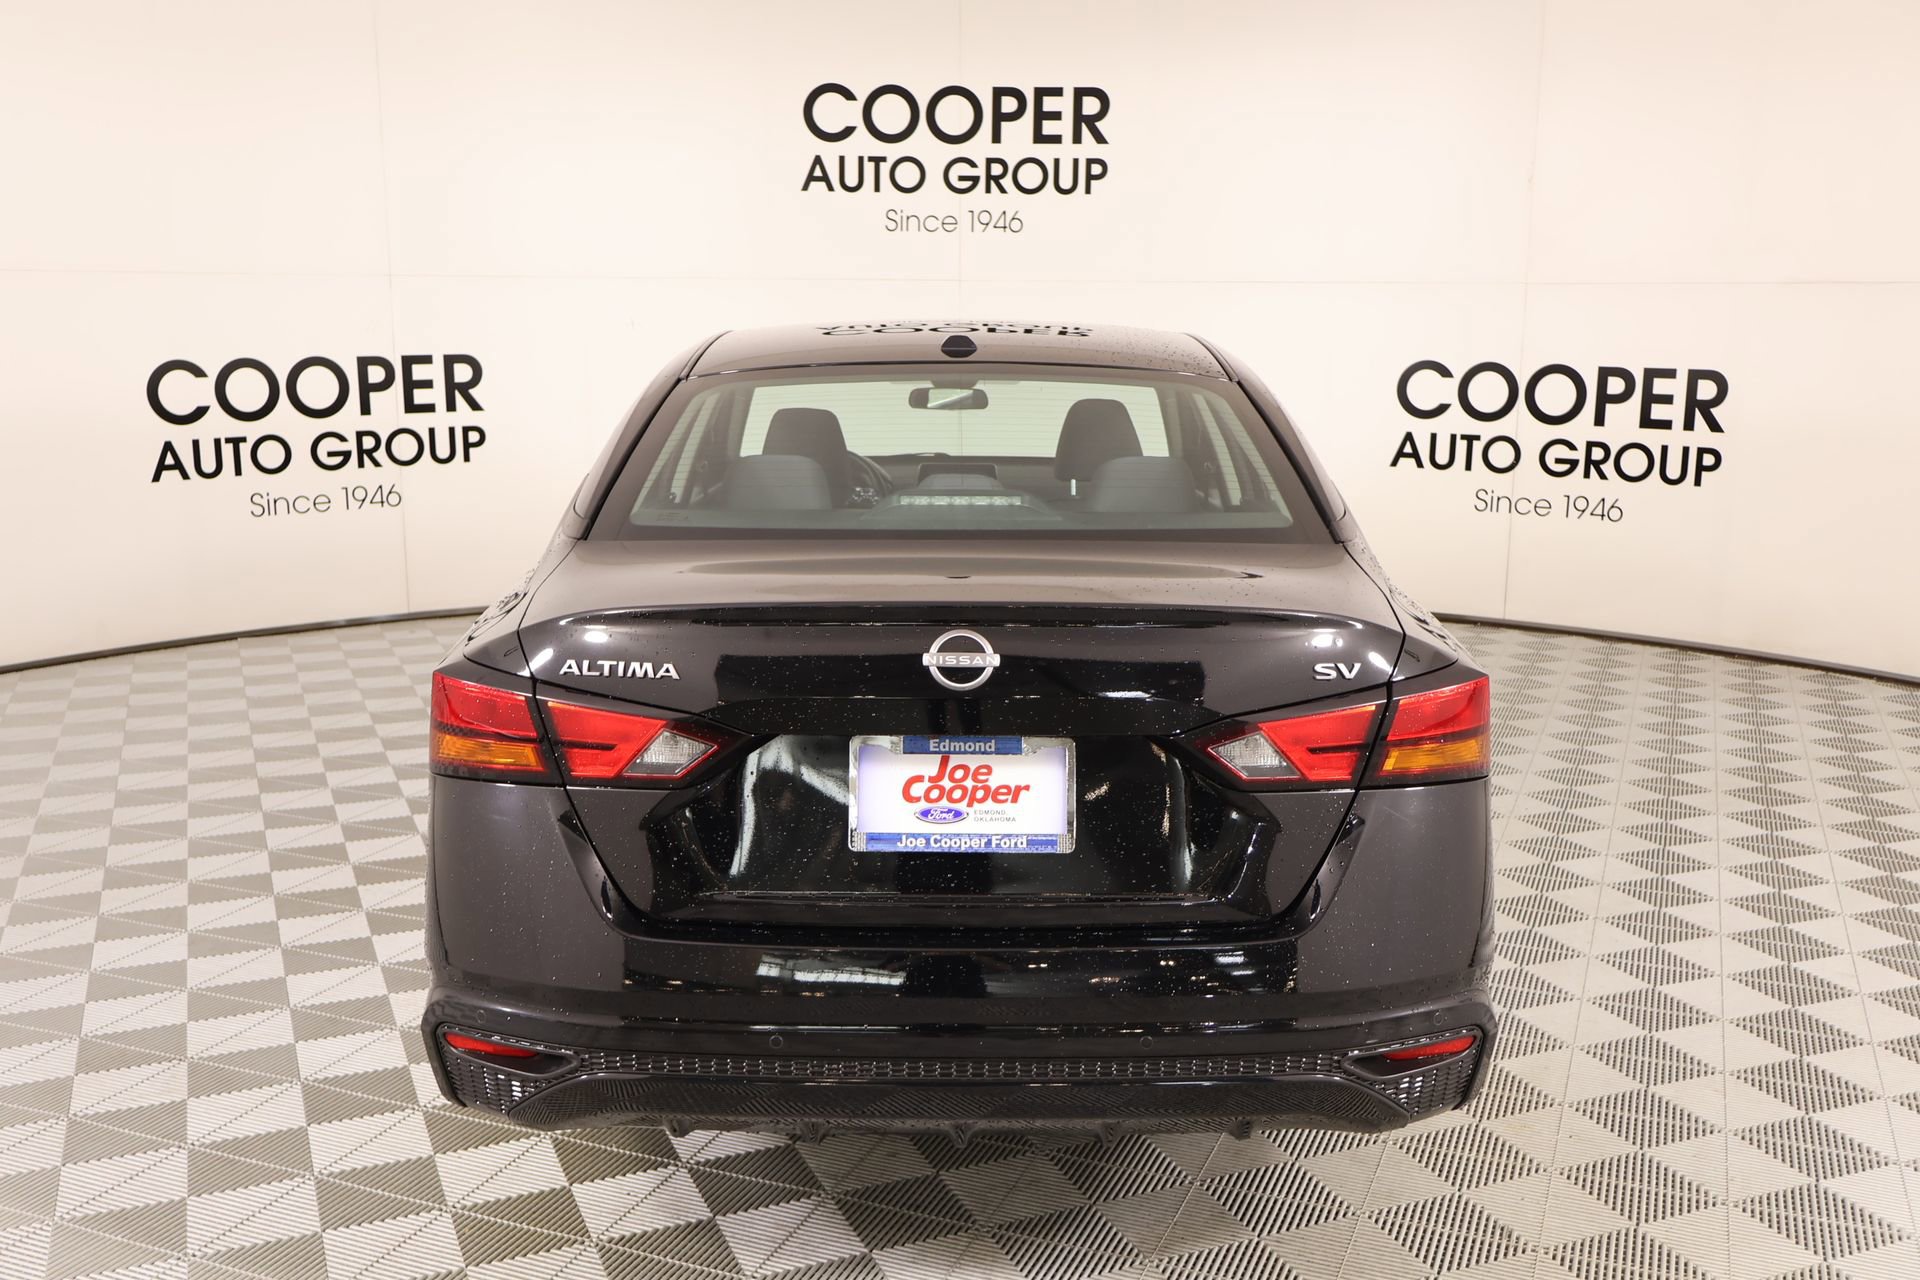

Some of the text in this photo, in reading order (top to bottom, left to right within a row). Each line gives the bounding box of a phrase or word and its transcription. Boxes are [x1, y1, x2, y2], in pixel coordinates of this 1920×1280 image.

[803, 82, 1110, 145] COOPER
[801, 154, 1108, 196] AUTO GROUP
[885, 209, 1024, 233] Since 1946
[146, 353, 485, 426] COOPER
[1396, 359, 1729, 434] COOPER
[151, 425, 487, 484] AUTO GROUP
[1389, 431, 1723, 488] AUTO GROUP
[250, 483, 402, 518] Since 1946
[1473, 488, 1624, 523] Since 1946
[559, 659, 680, 680] ALTIMA
[926, 655, 998, 665] NISSAN
[1313, 662, 1362, 680] SV
[929, 739, 996, 752] Edmond
[927, 754, 993, 784] Joe
[901, 774, 1031, 808] Cooper
[896, 834, 1028, 850] Joe Cooper Ford
